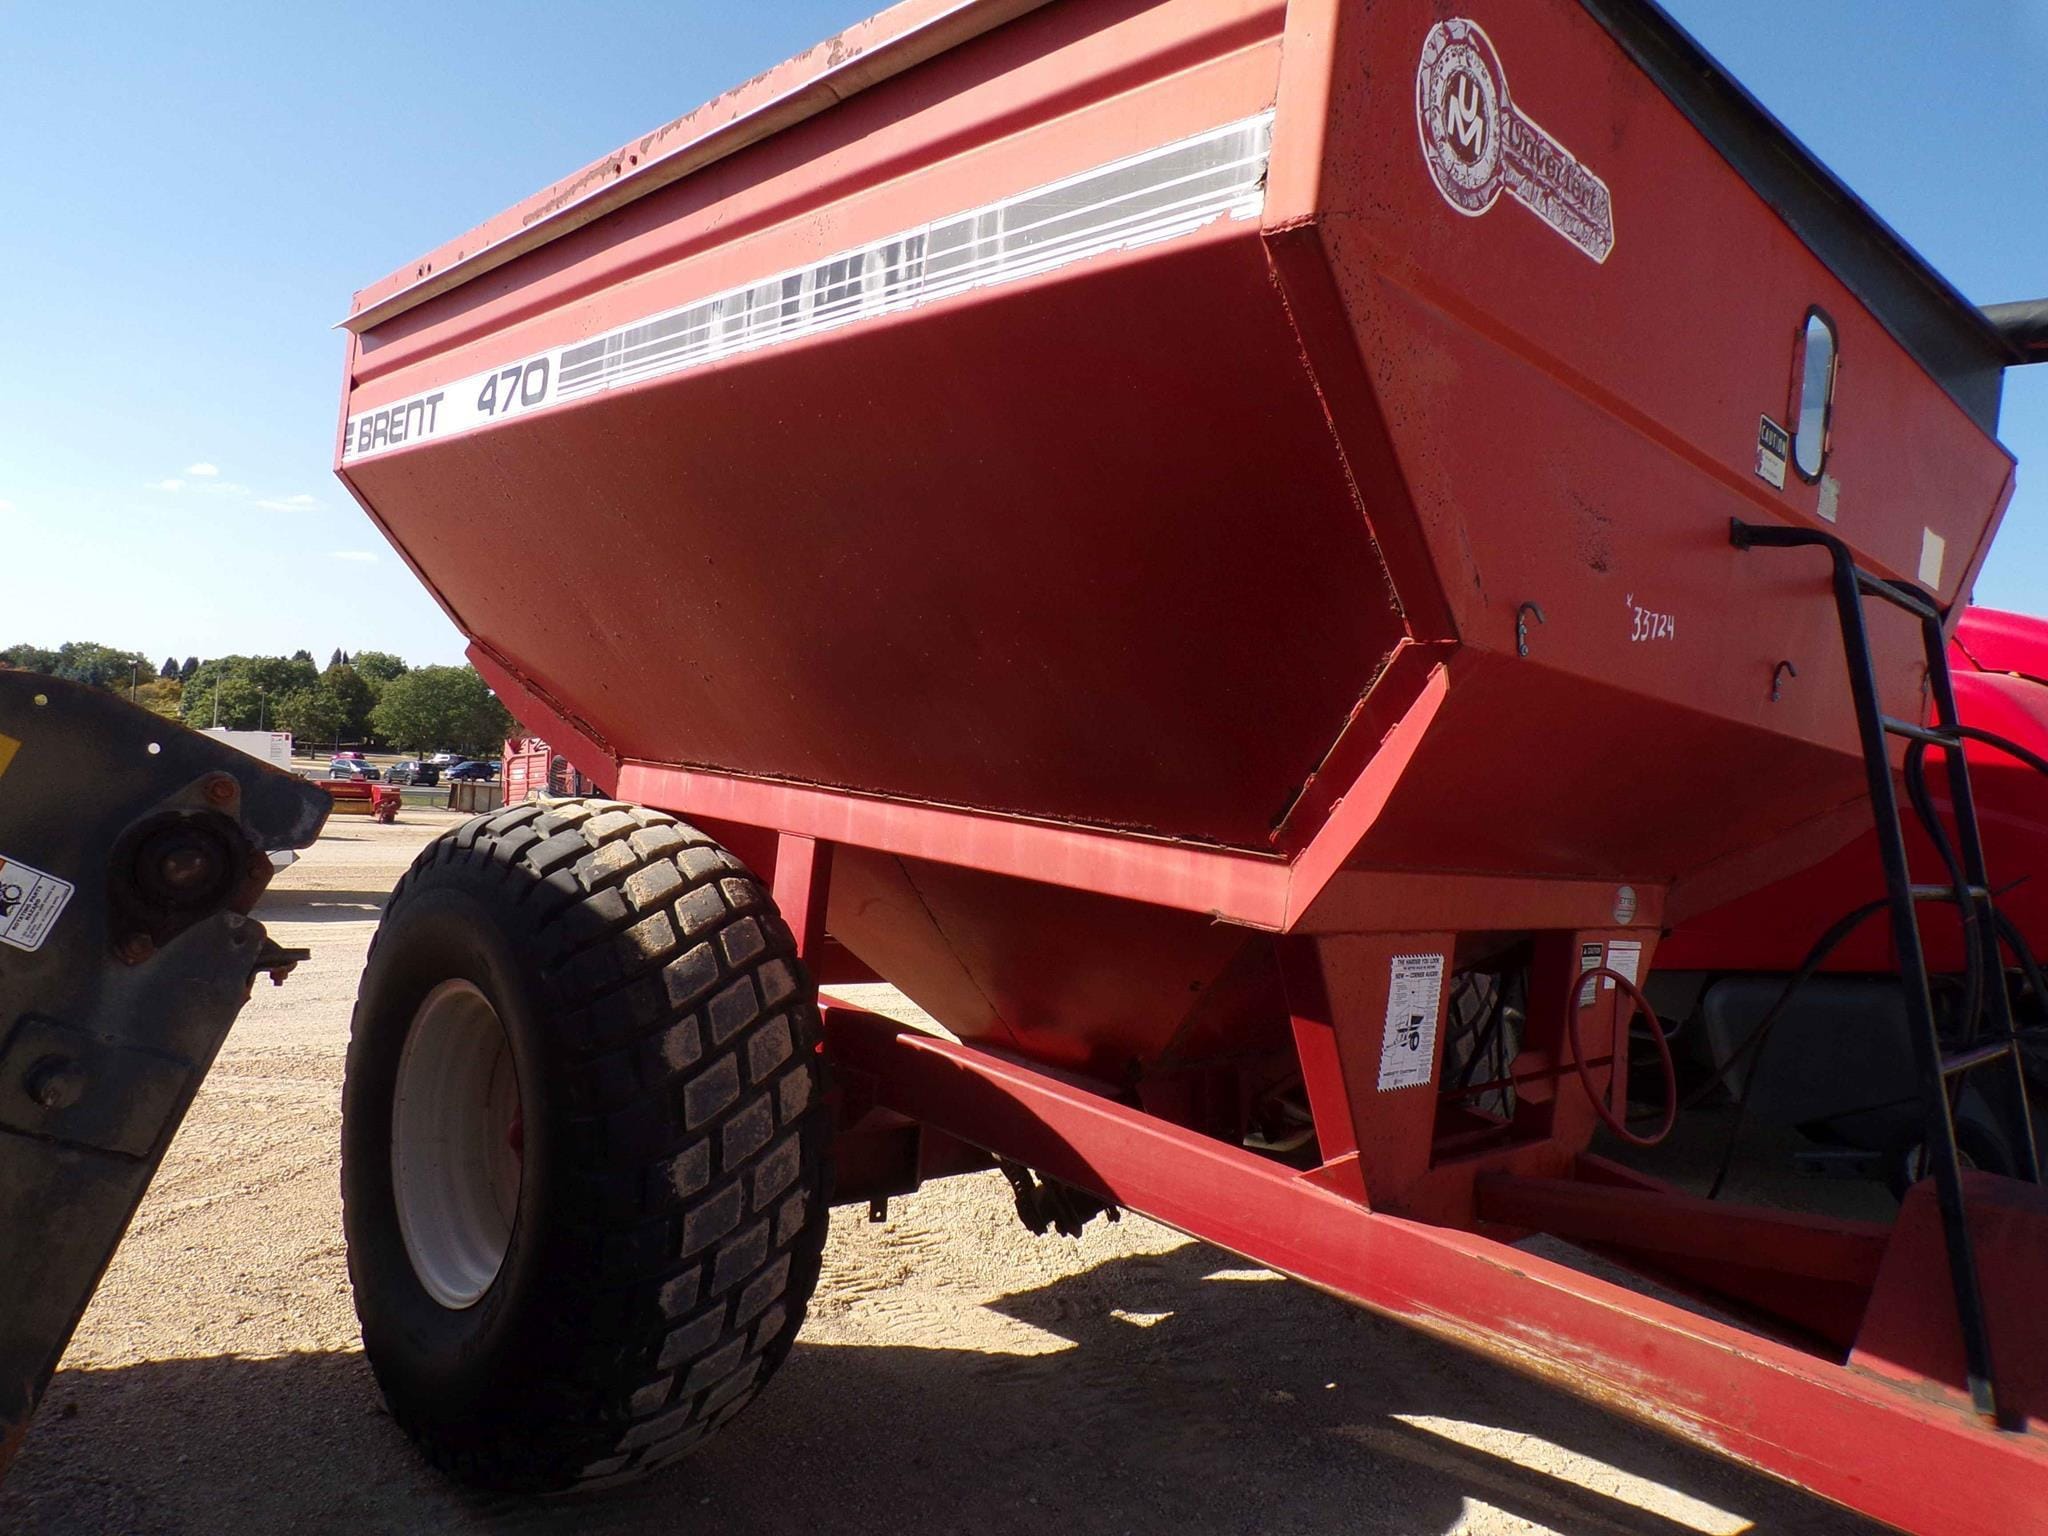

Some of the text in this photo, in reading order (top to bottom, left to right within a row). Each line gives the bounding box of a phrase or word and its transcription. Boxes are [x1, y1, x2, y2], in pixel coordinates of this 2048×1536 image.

[358, 357, 550, 453] BRENT 470
[1631, 606, 1675, 642] 33724
[12, 902, 32, 931] ROTATING
[29, 885, 43, 904] PARTS
[25, 898, 41, 921] HAZARD
